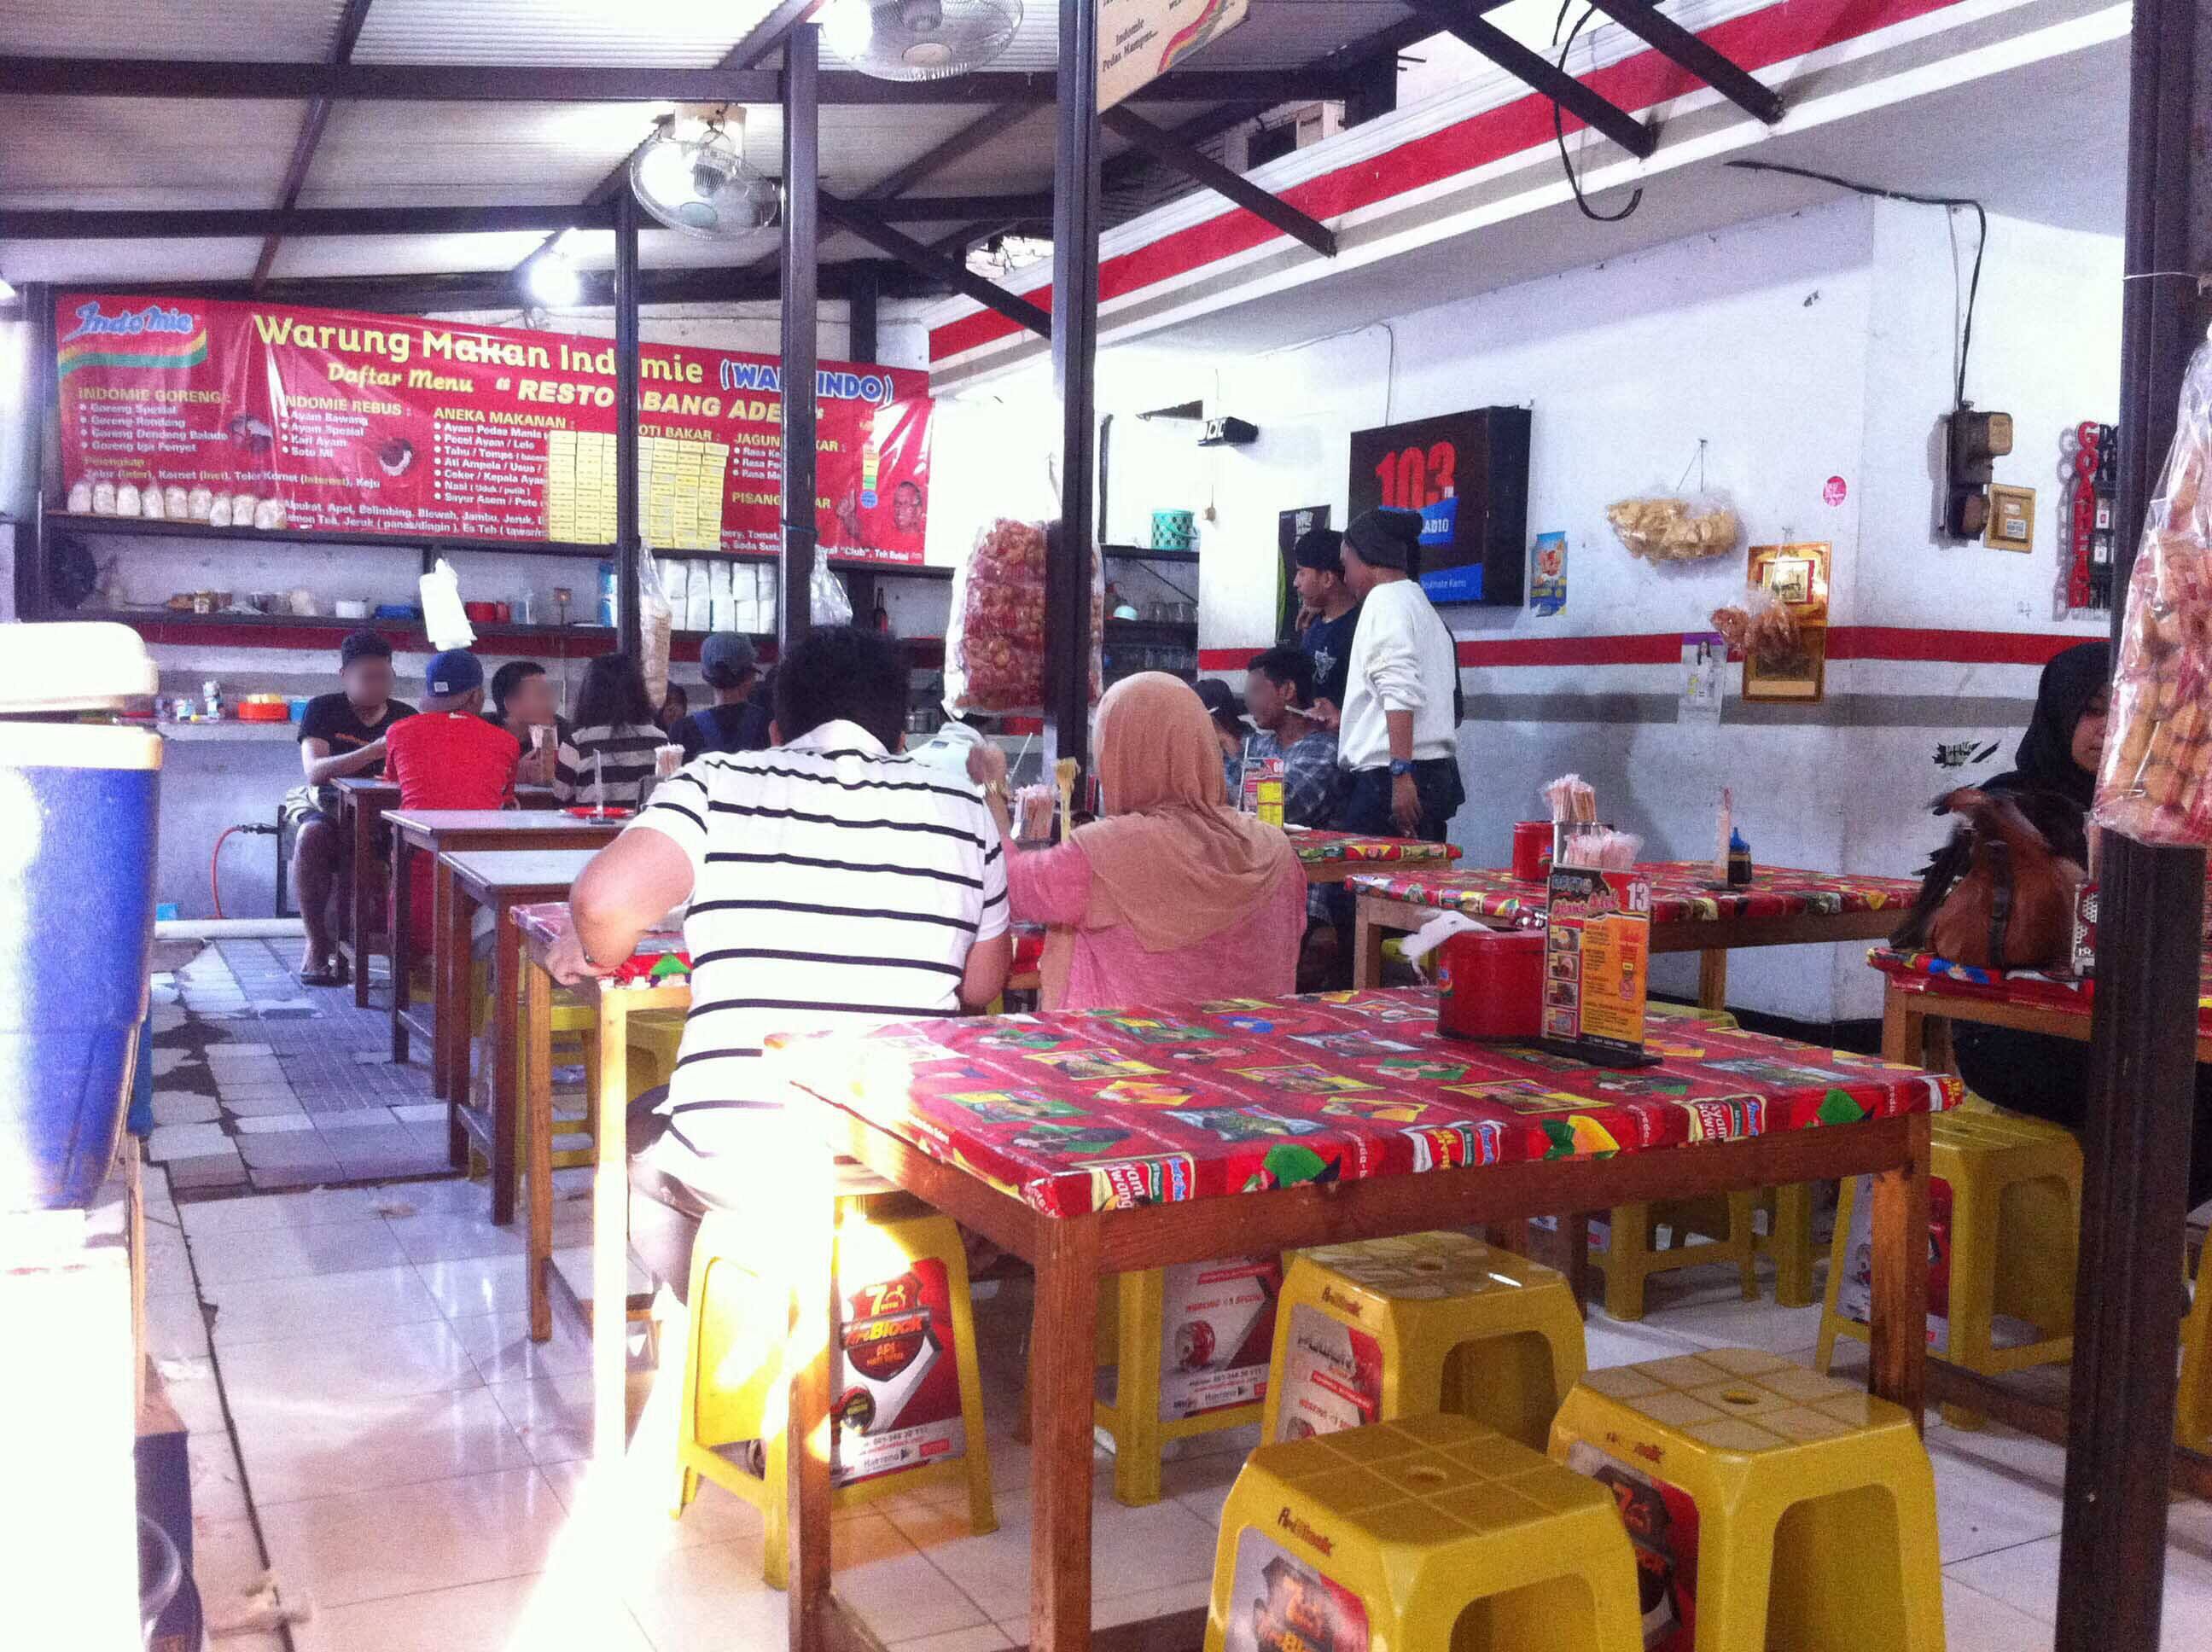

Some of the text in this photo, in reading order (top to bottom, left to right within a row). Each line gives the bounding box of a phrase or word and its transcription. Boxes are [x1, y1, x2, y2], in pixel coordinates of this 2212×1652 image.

[255, 315, 410, 363] Warung
[422, 330, 550, 369] Makan
[560, 343, 703, 384] Indmie
[327, 362, 474, 393] Daftar Menu
[79, 388, 220, 404] INDOMIE GORENG
[517, 379, 781, 424] RESTO BANG ADE
[285, 396, 402, 416] NDOMIE REBUS
[434, 407, 567, 429] ANEKA MAKANAN
[445, 422, 474, 434] Ayam
[639, 425, 713, 441] OTI BAKAR
[445, 433, 473, 445] Pecel
[475, 436, 504, 449] Ayam
[734, 433, 781, 447] JAGUN
[445, 445, 470, 457] Tahu
[484, 471, 518, 484] Kepala
[1421, 519, 1450, 534] ADIO
[1627, 881, 1651, 912] 13
[1123, 1162, 1145, 1196] yam
